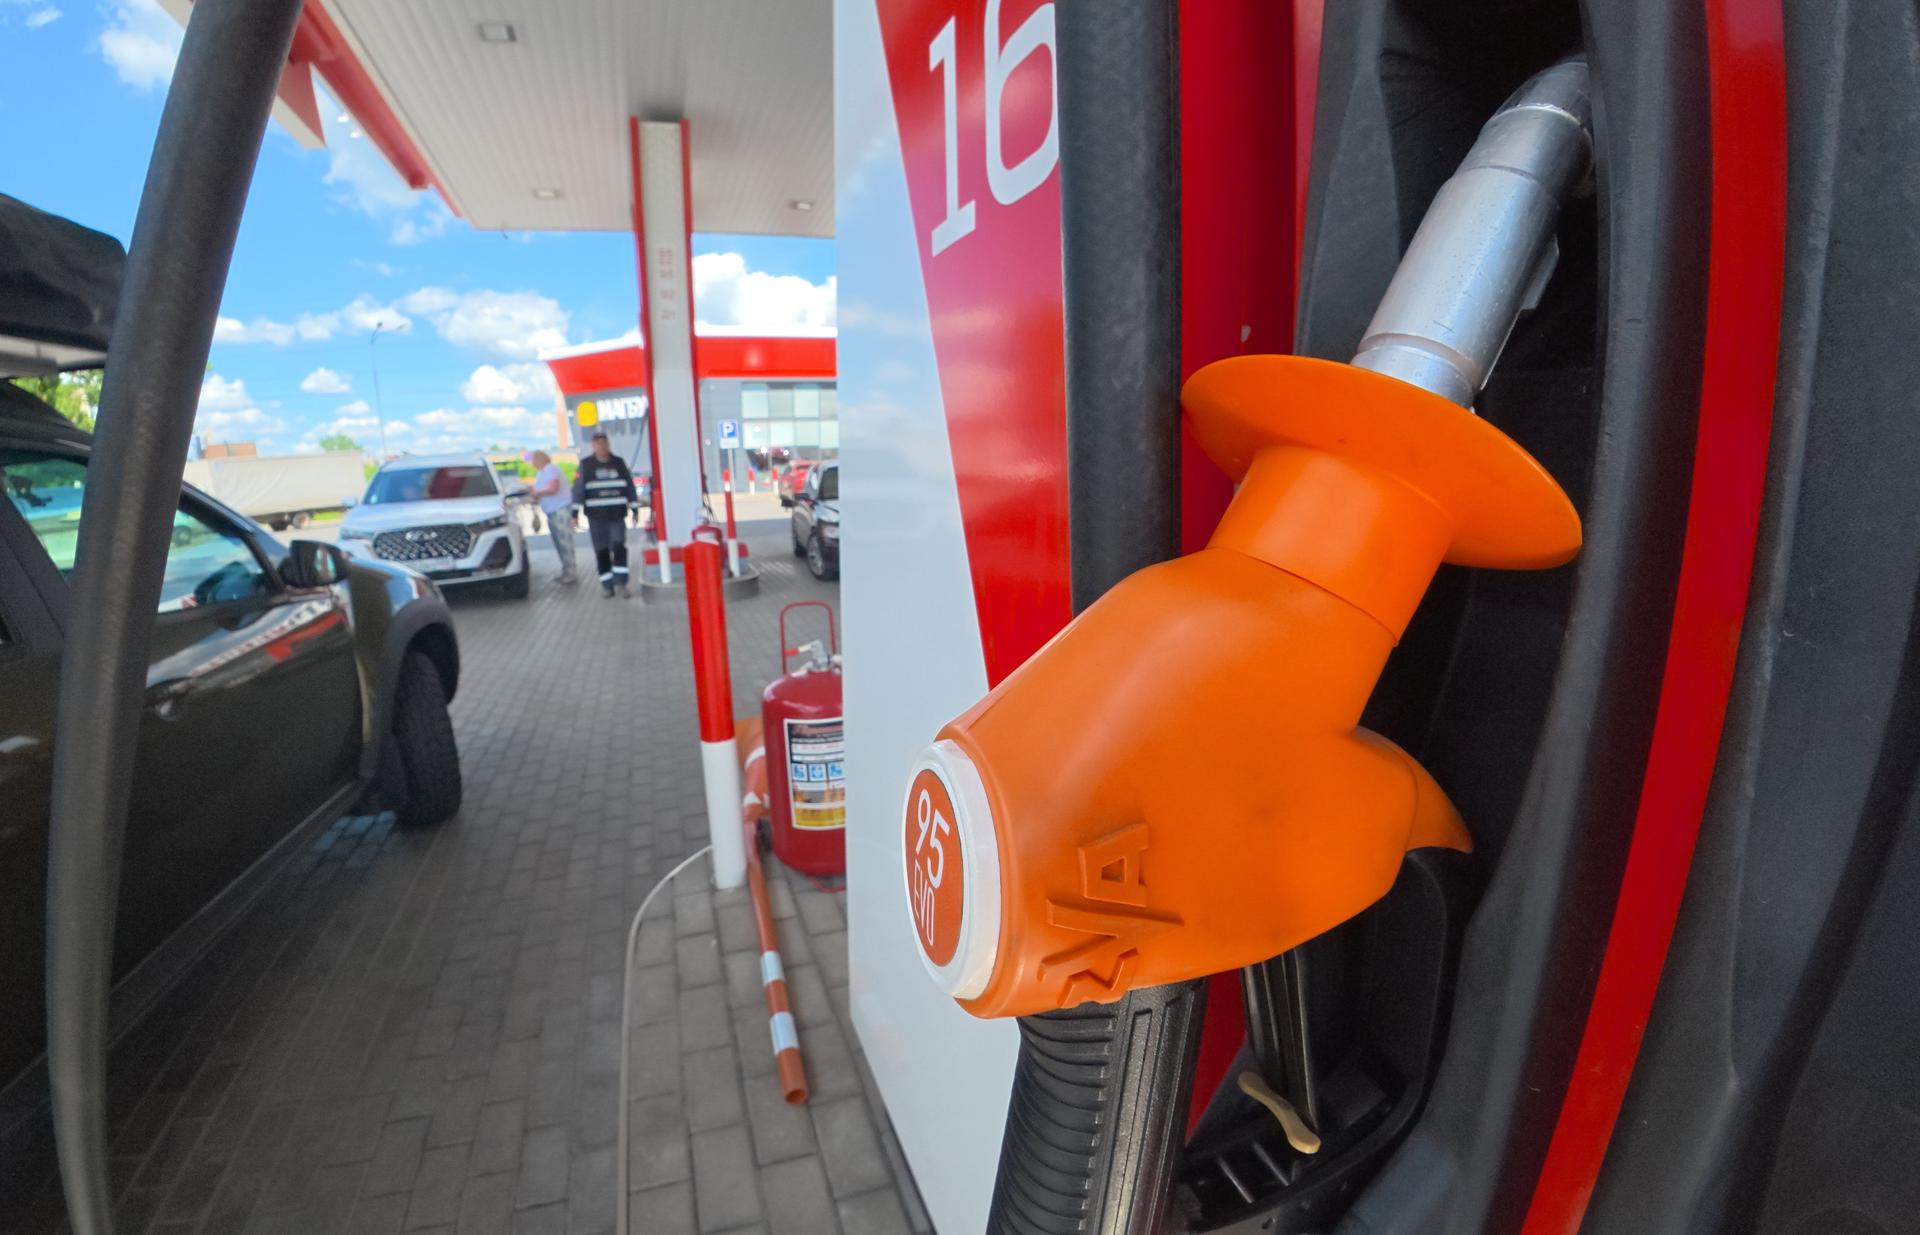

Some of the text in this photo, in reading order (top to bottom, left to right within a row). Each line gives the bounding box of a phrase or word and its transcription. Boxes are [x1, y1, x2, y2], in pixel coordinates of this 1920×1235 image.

[929, 0, 1059, 258] 16
[915, 788, 951, 889] 95
[913, 857, 935, 947] EVO
